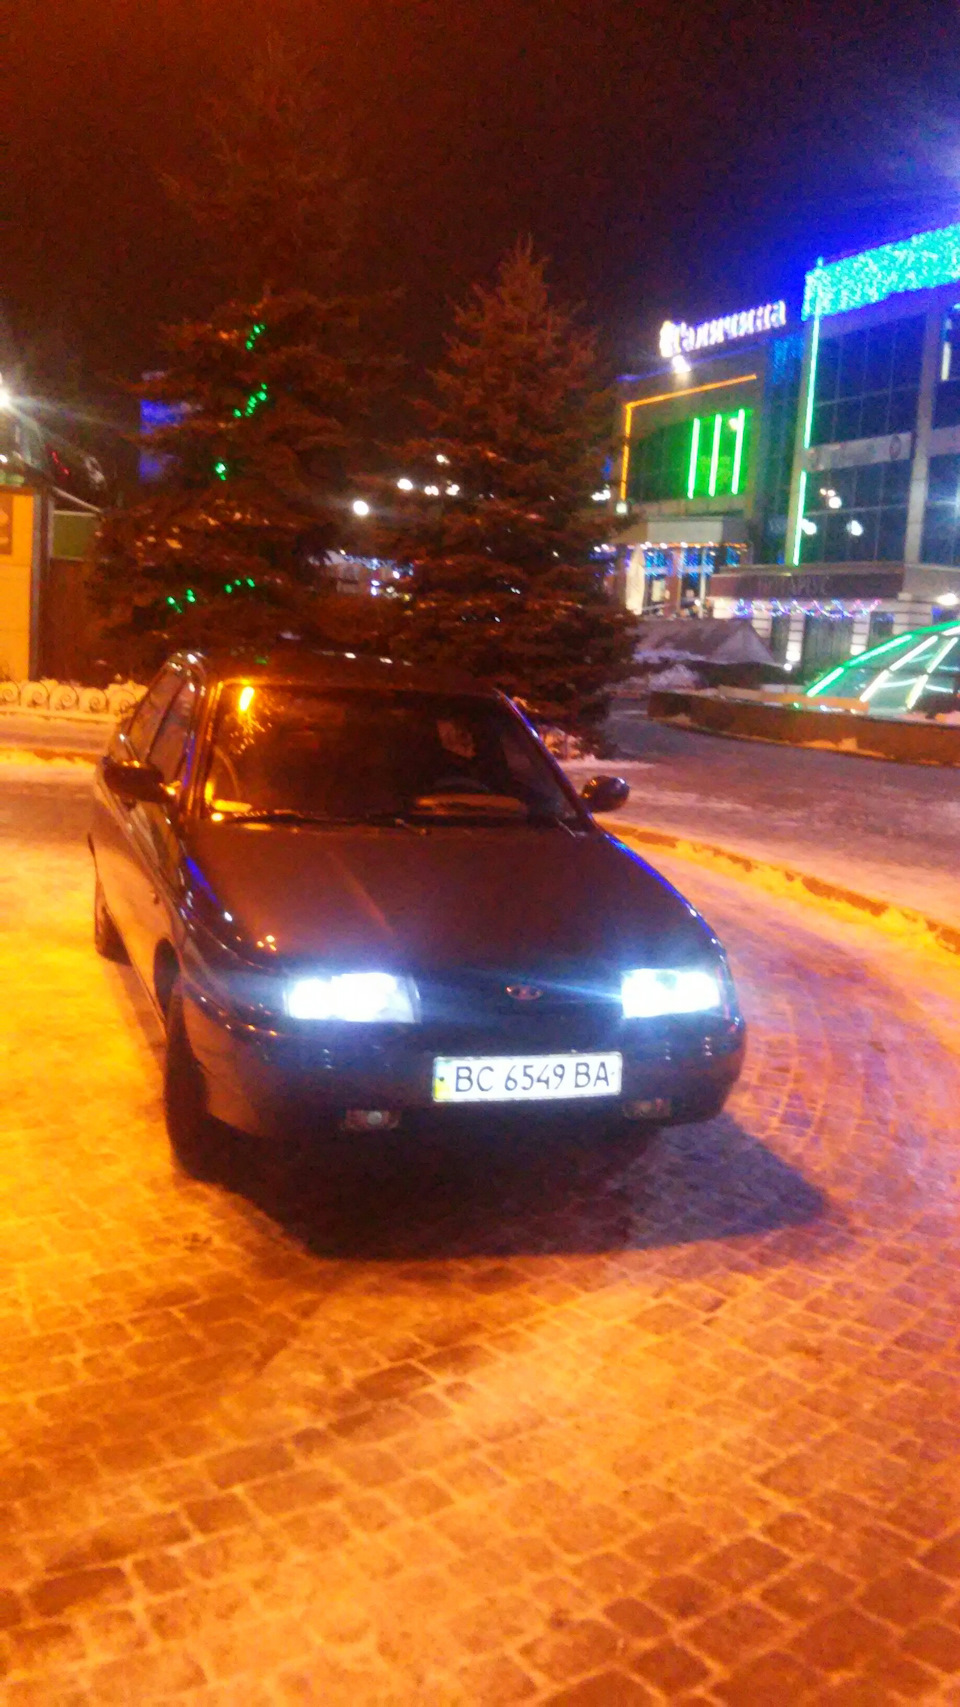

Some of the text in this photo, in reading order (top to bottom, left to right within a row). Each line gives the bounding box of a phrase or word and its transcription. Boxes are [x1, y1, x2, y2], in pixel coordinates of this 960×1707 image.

[455, 1061, 610, 1092] BC 6549 BA
